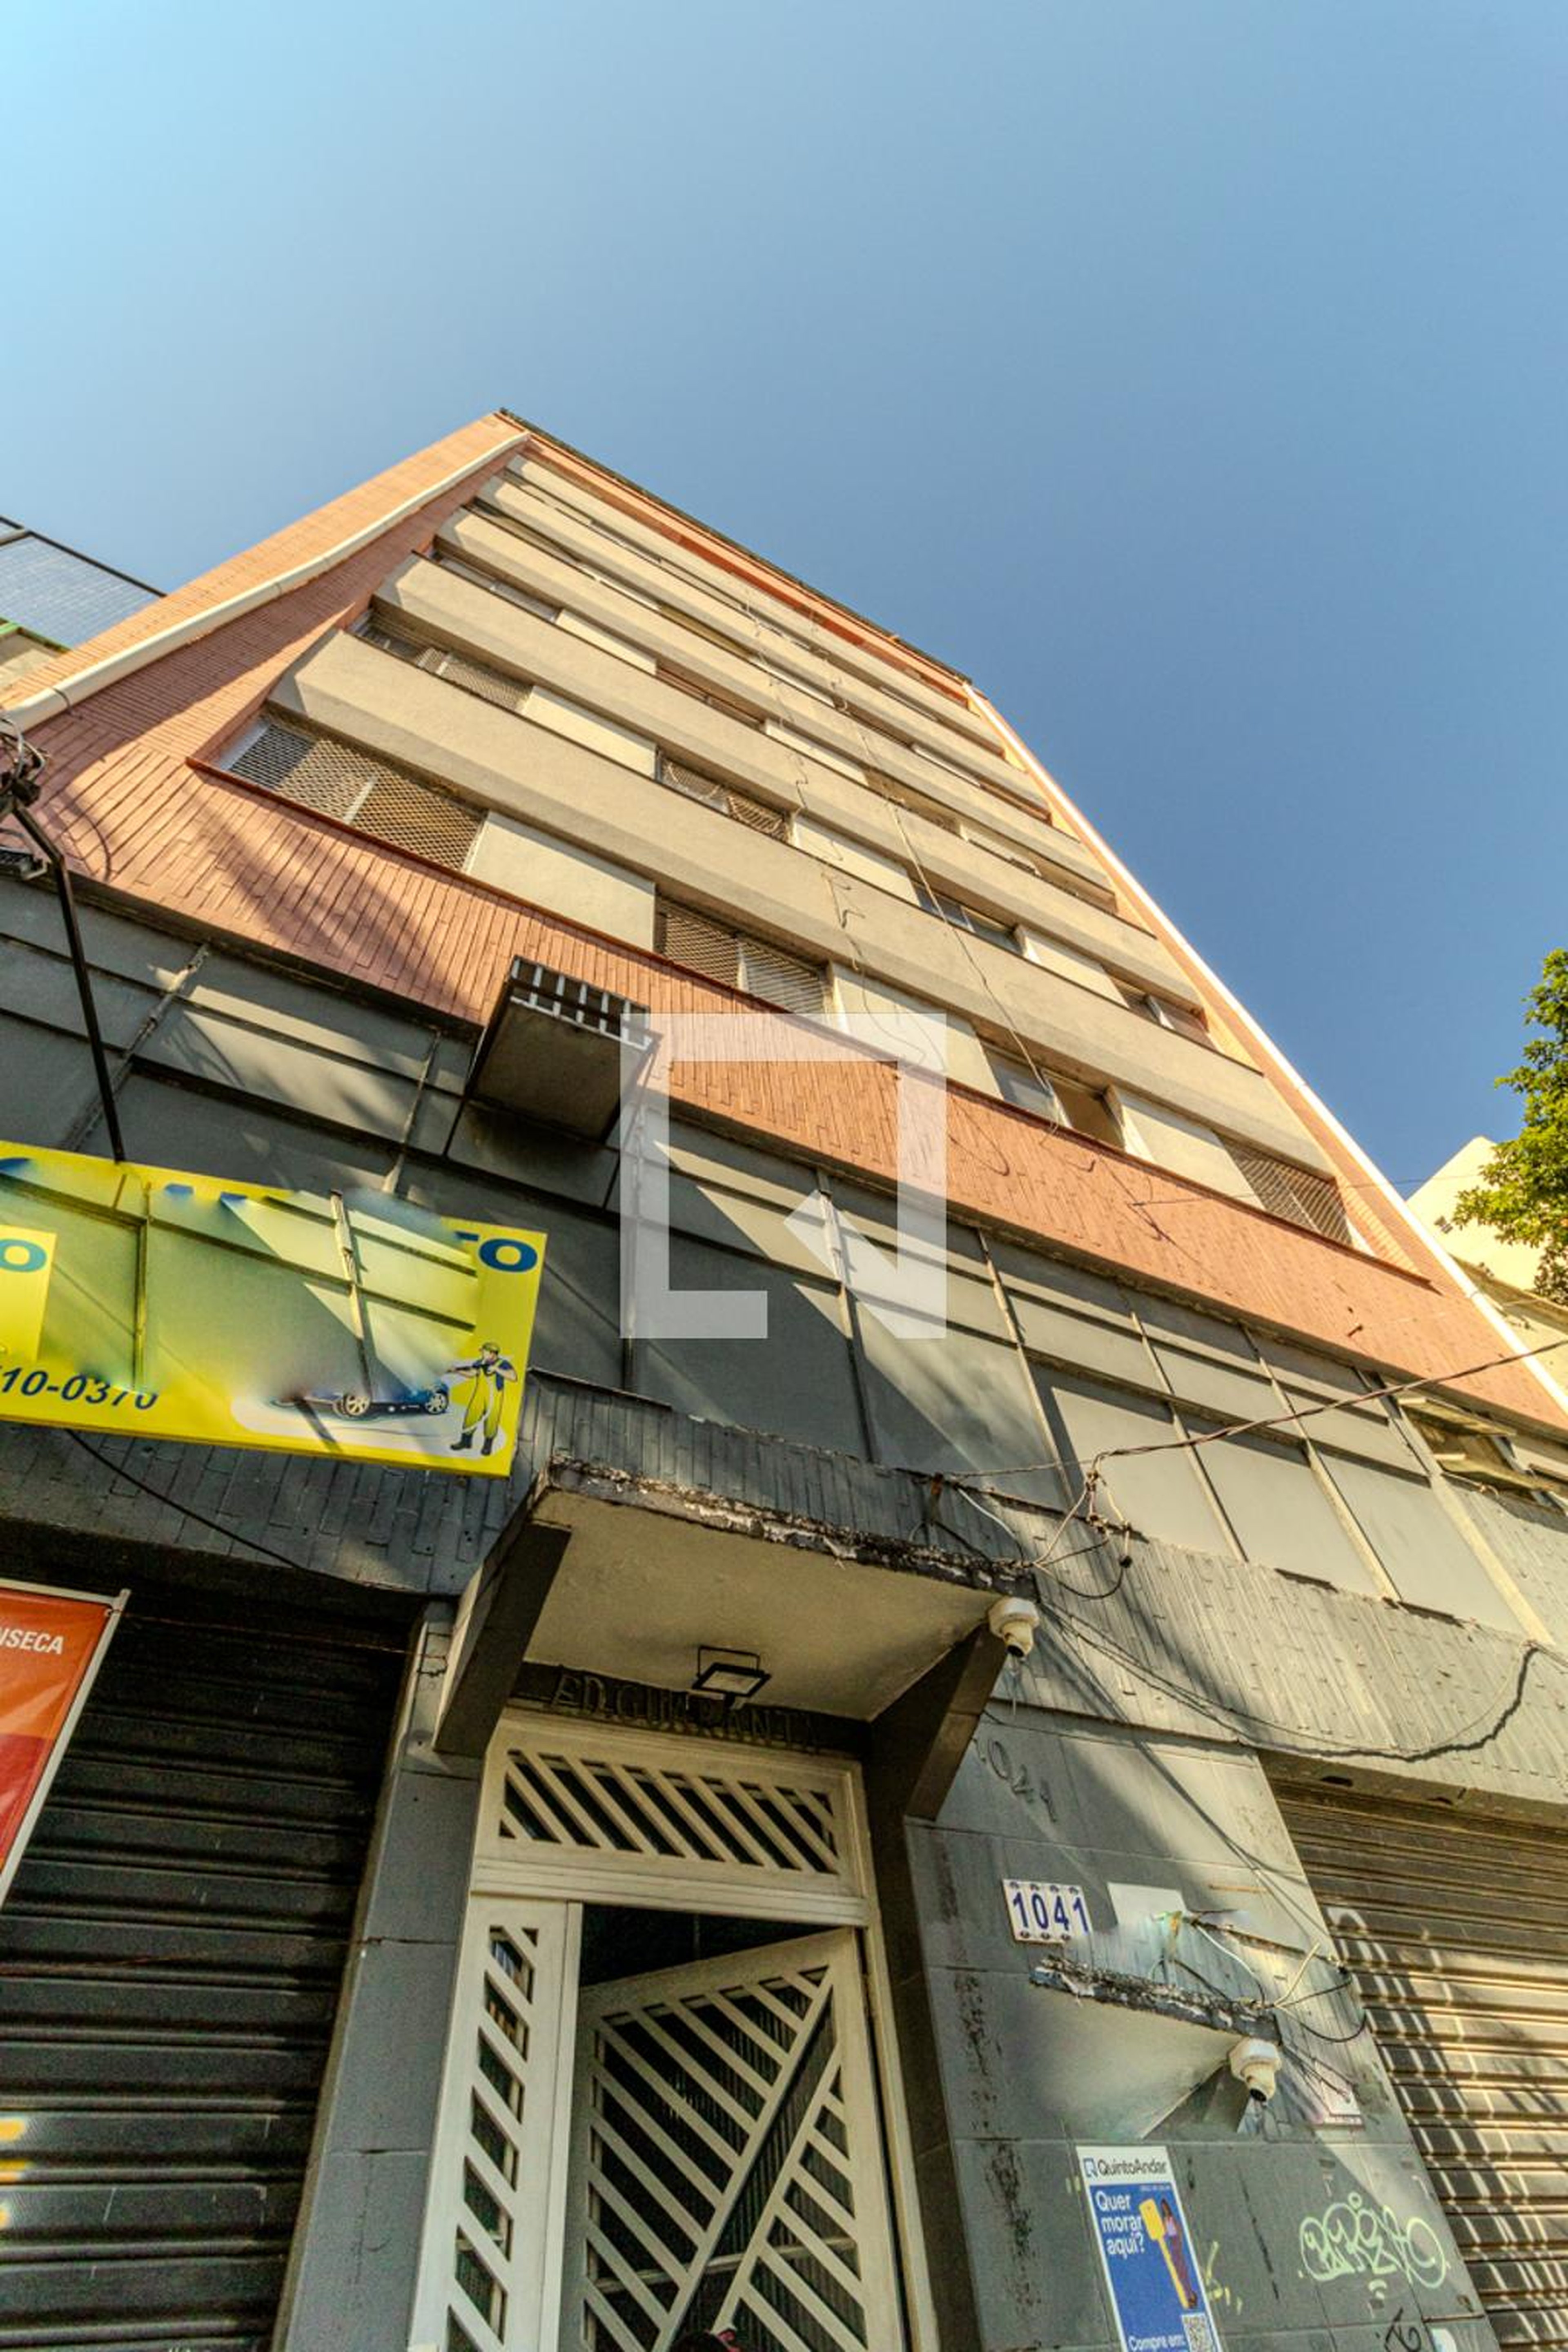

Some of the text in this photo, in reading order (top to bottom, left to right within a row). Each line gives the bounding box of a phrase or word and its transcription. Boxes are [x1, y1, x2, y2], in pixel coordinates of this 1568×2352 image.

[1013, 1892, 1090, 1935] 1041
[1095, 2191, 1130, 2211] Quer
[1101, 2215, 1143, 2232] morar
[1106, 2233, 1145, 2259] aqui?
